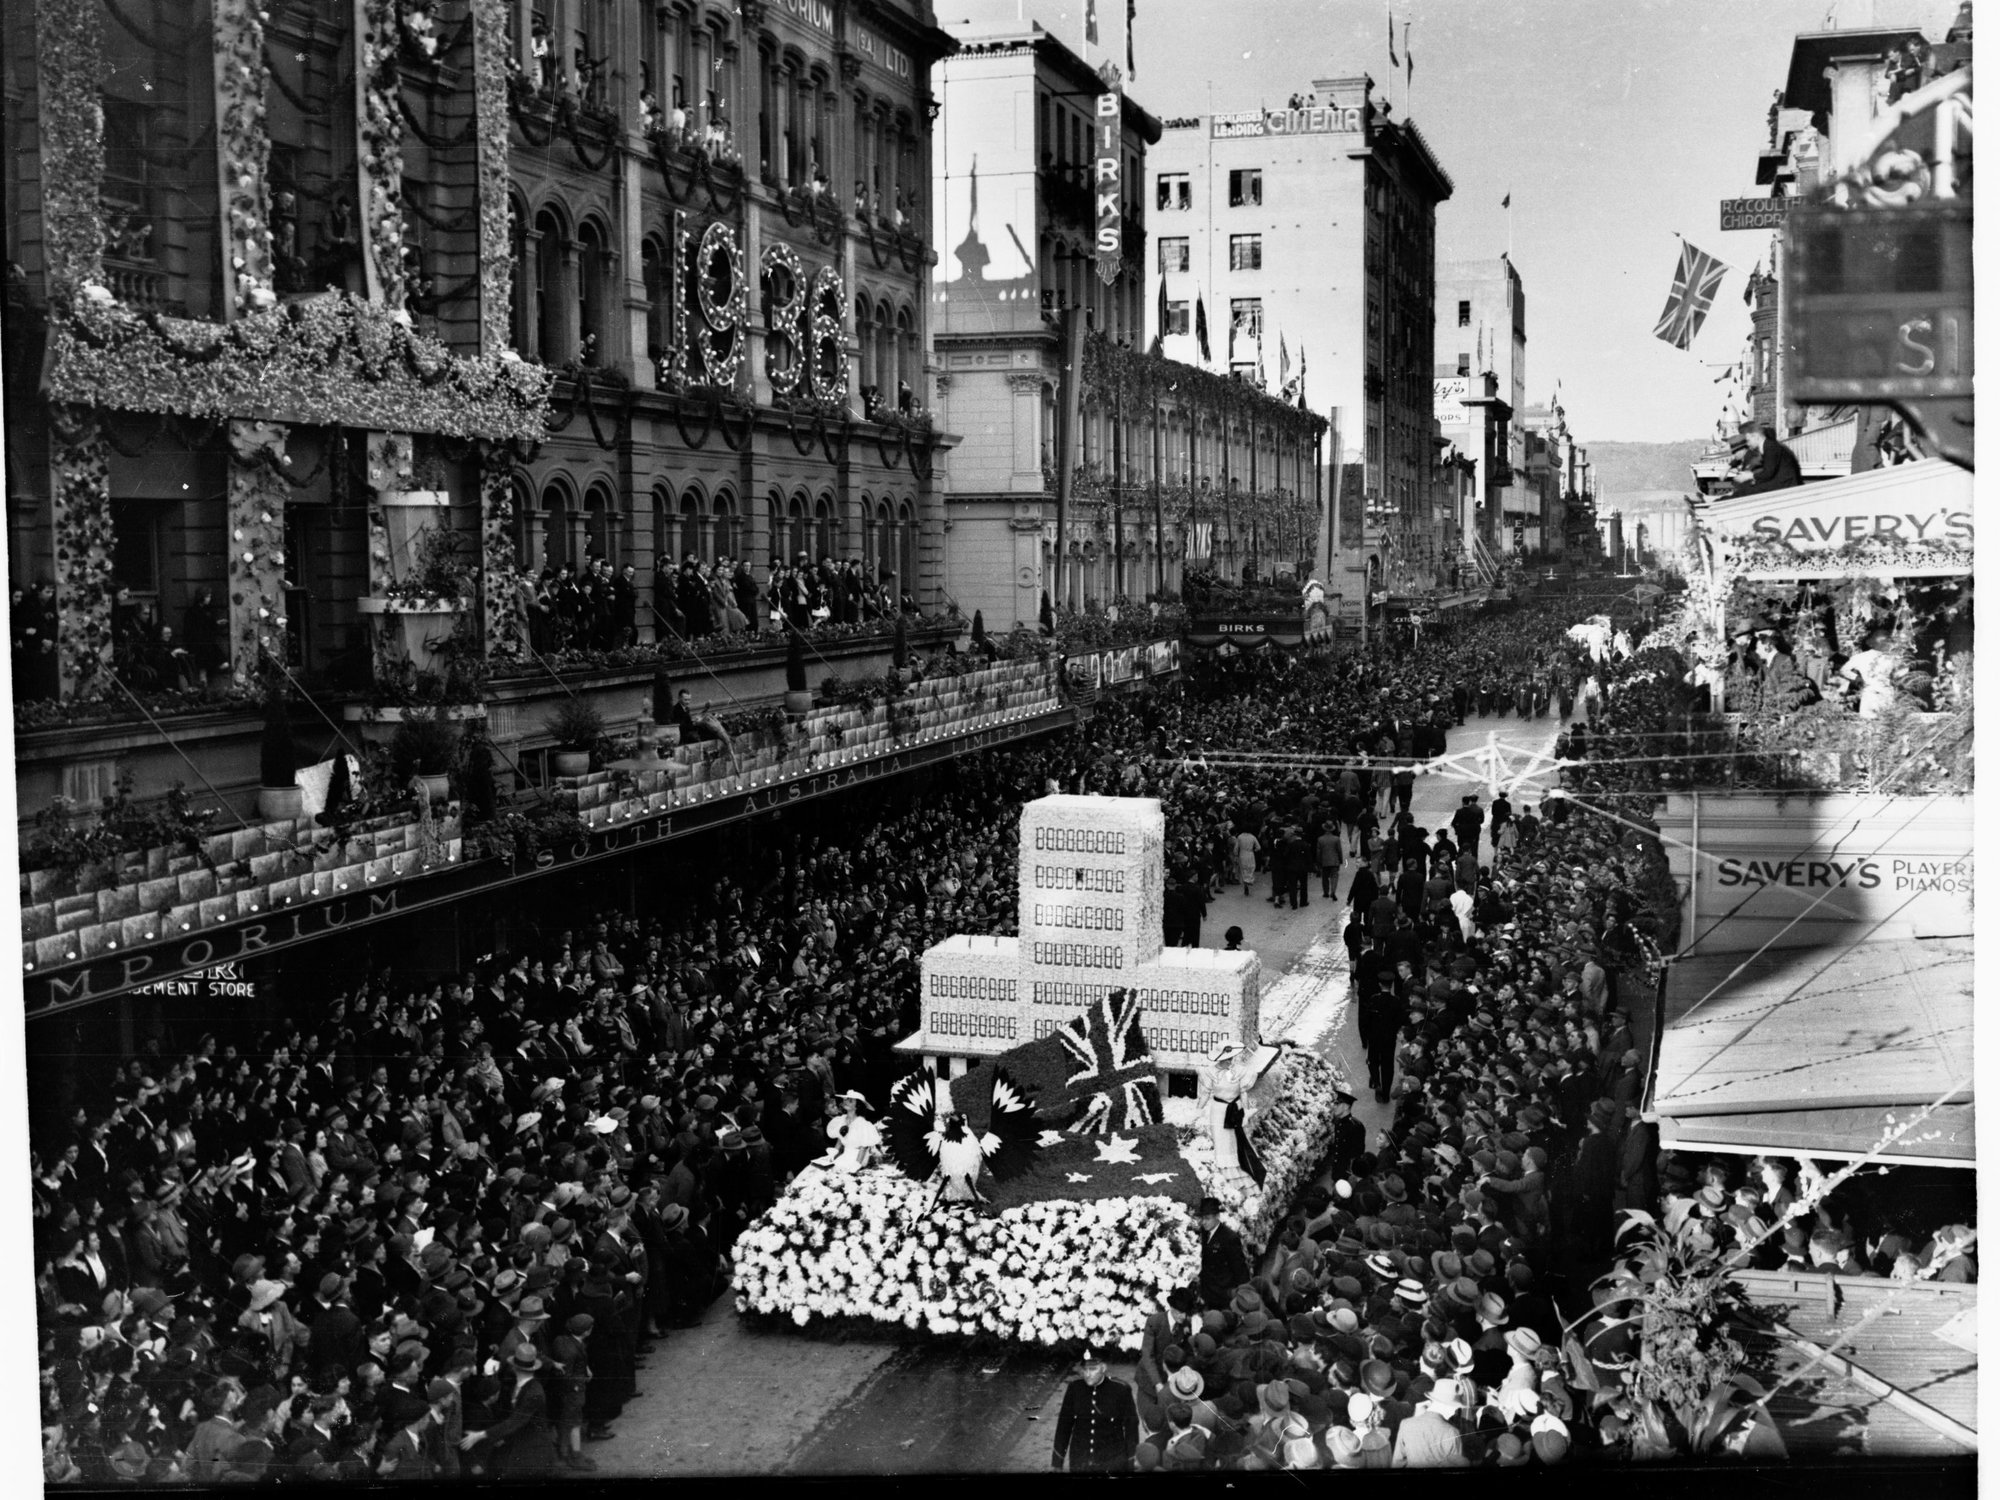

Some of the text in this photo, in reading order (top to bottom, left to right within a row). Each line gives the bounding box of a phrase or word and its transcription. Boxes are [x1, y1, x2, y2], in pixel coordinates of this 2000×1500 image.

[1267, 108, 1361, 133] CINEMA
[1097, 92, 1120, 252] BIRKS
[1752, 508, 1974, 542] SAVERY'S
[1219, 624, 1265, 633] BIRKS
[743, 757, 901, 814] AUSTRALIA
[1718, 857, 1967, 889] SAVERY'S PLAYER
[1896, 876, 1971, 893] PIANOS
[208, 981, 255, 998] STORE
